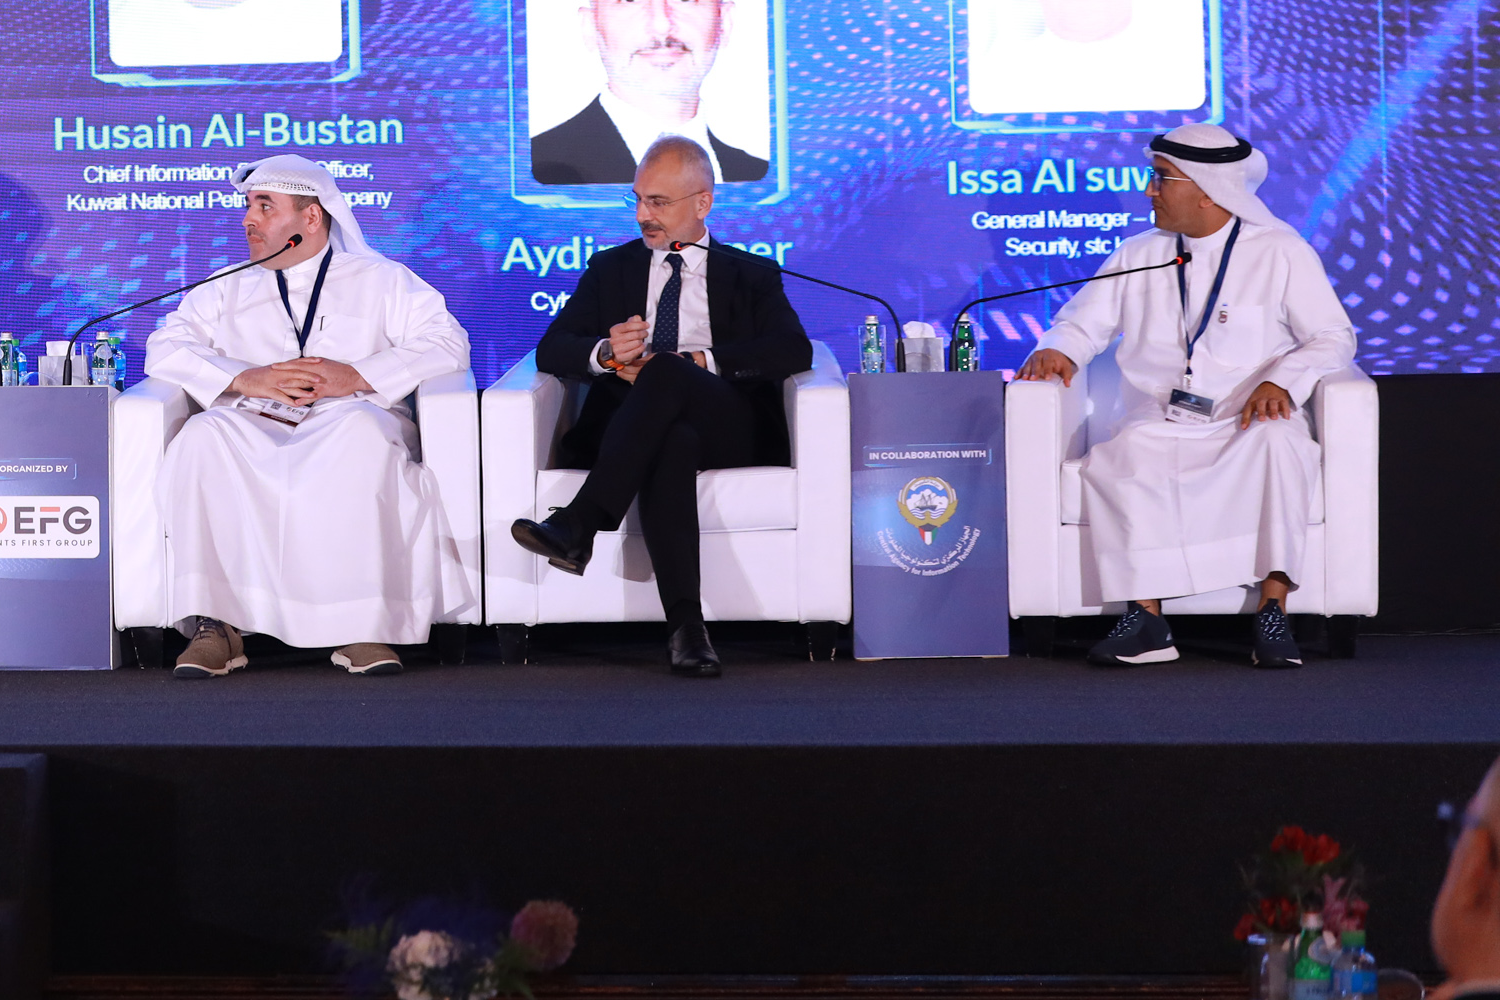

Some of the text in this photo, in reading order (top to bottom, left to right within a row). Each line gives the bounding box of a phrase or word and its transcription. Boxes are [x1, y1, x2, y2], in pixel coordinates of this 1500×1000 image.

[54, 112, 404, 151] Husain Al-Bustan
[83, 165, 131, 184] Chief
[135, 163, 233, 182] Information
[316, 160, 375, 181] Officer,
[947, 158, 1154, 195] Issa Al suw
[67, 190, 393, 212] Kuwait National Petr pany
[971, 210, 1046, 230] General
[1048, 209, 1132, 231] Manager
[501, 236, 619, 277] Aydi
[1005, 236, 1081, 258] Security,
[1085, 236, 1112, 255] stc
[869, 450, 986, 460] IN COLLABORATION WITH
[0, 465, 68, 473] ORGANIZED BY
[14, 506, 92, 535] EFG
[22, 539, 51, 547] FIRST
[55, 539, 93, 547] GROUP
